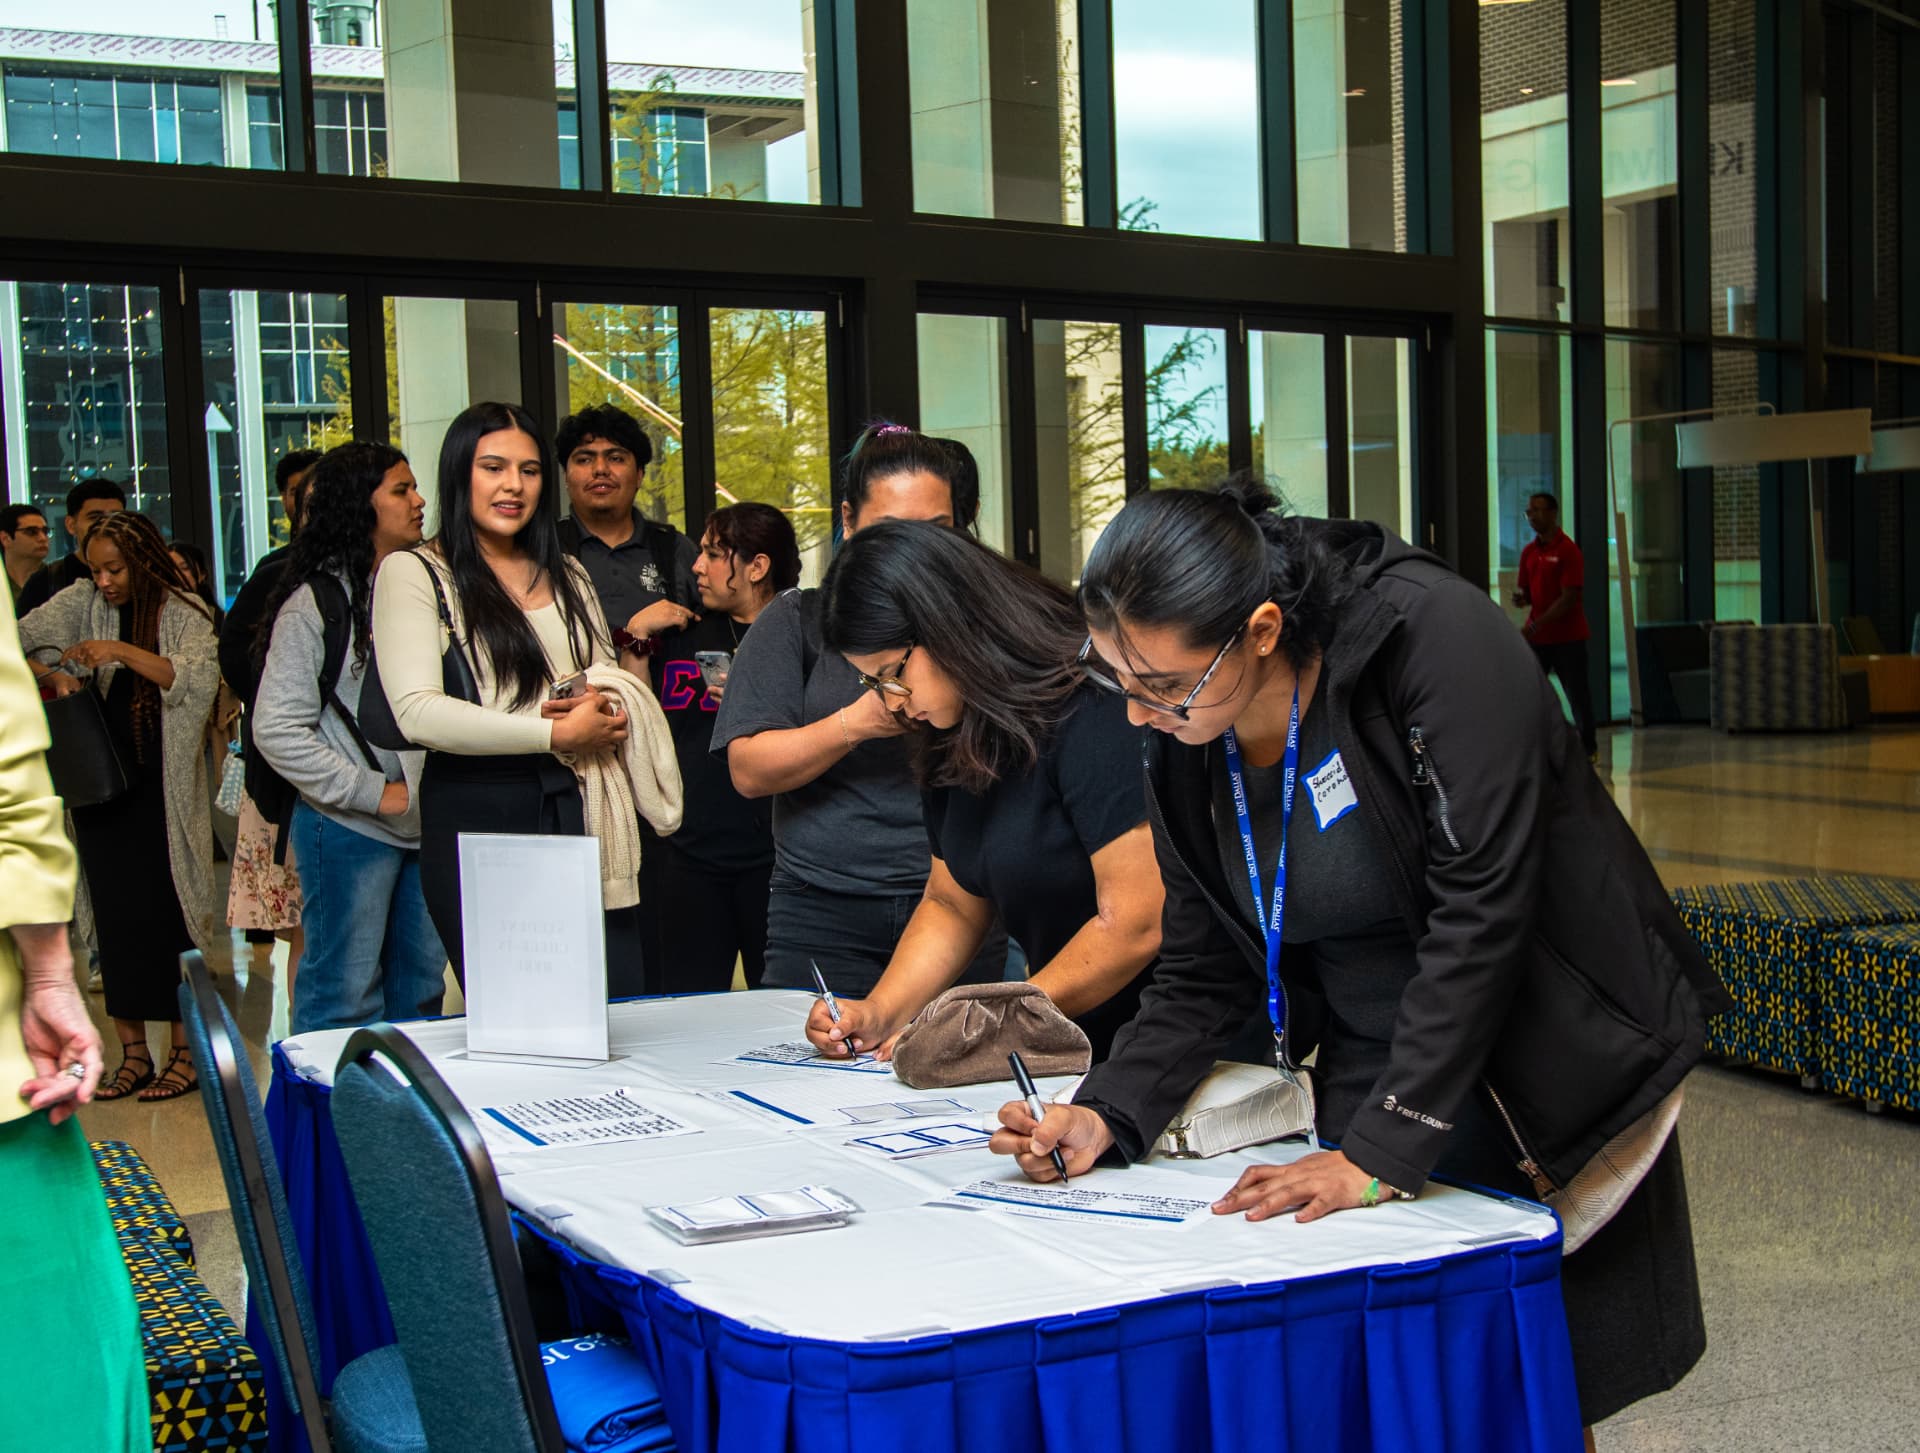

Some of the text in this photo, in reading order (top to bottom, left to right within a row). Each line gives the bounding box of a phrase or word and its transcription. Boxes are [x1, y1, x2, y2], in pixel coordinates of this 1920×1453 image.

[1289, 721, 1298, 750] DALLAS
[1288, 767, 1296, 784] UNT
[1230, 771, 1245, 816] UNT DALLAS
[1242, 833, 1257, 878] UNT DALLAS
[1274, 904, 1283, 930] DALLAS
[1397, 1106, 1421, 1120] FREE
